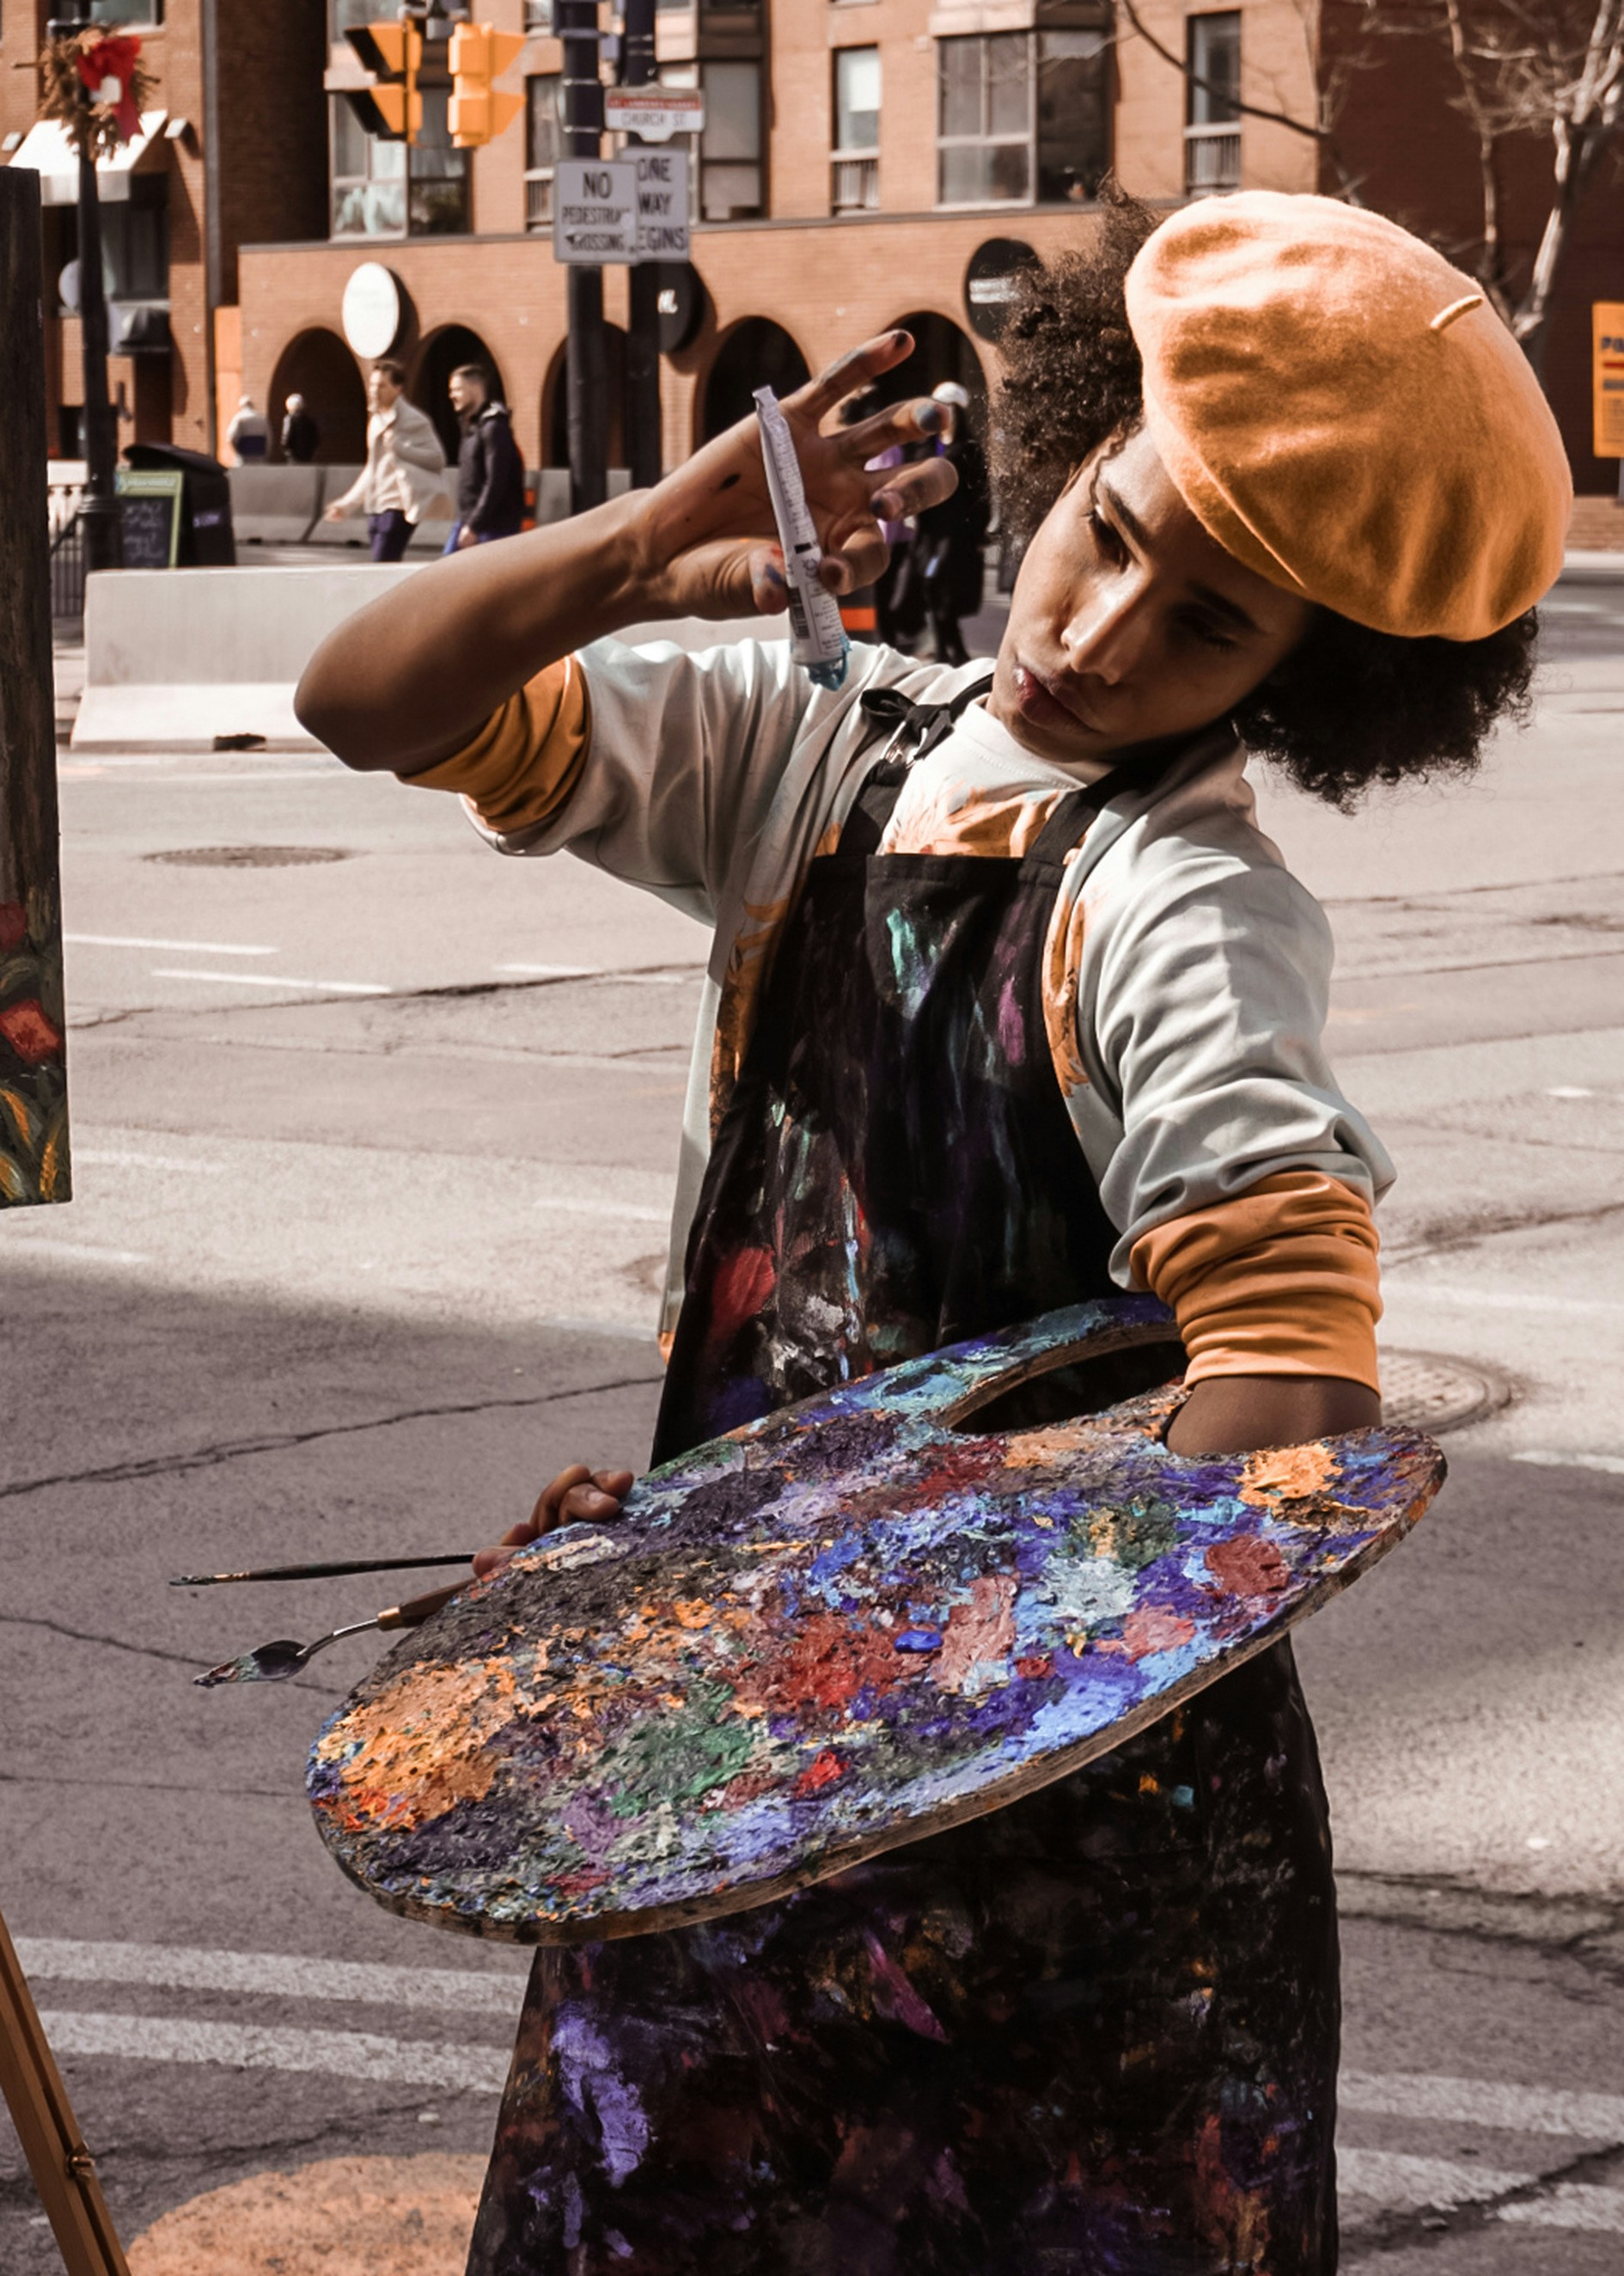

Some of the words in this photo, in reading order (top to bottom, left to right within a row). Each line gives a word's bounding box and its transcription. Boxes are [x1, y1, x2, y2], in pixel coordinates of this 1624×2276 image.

[638, 158, 671, 182] ONE
[583, 172, 613, 199] NO
[638, 193, 672, 215] WAY
[638, 226, 685, 251] EGINS
